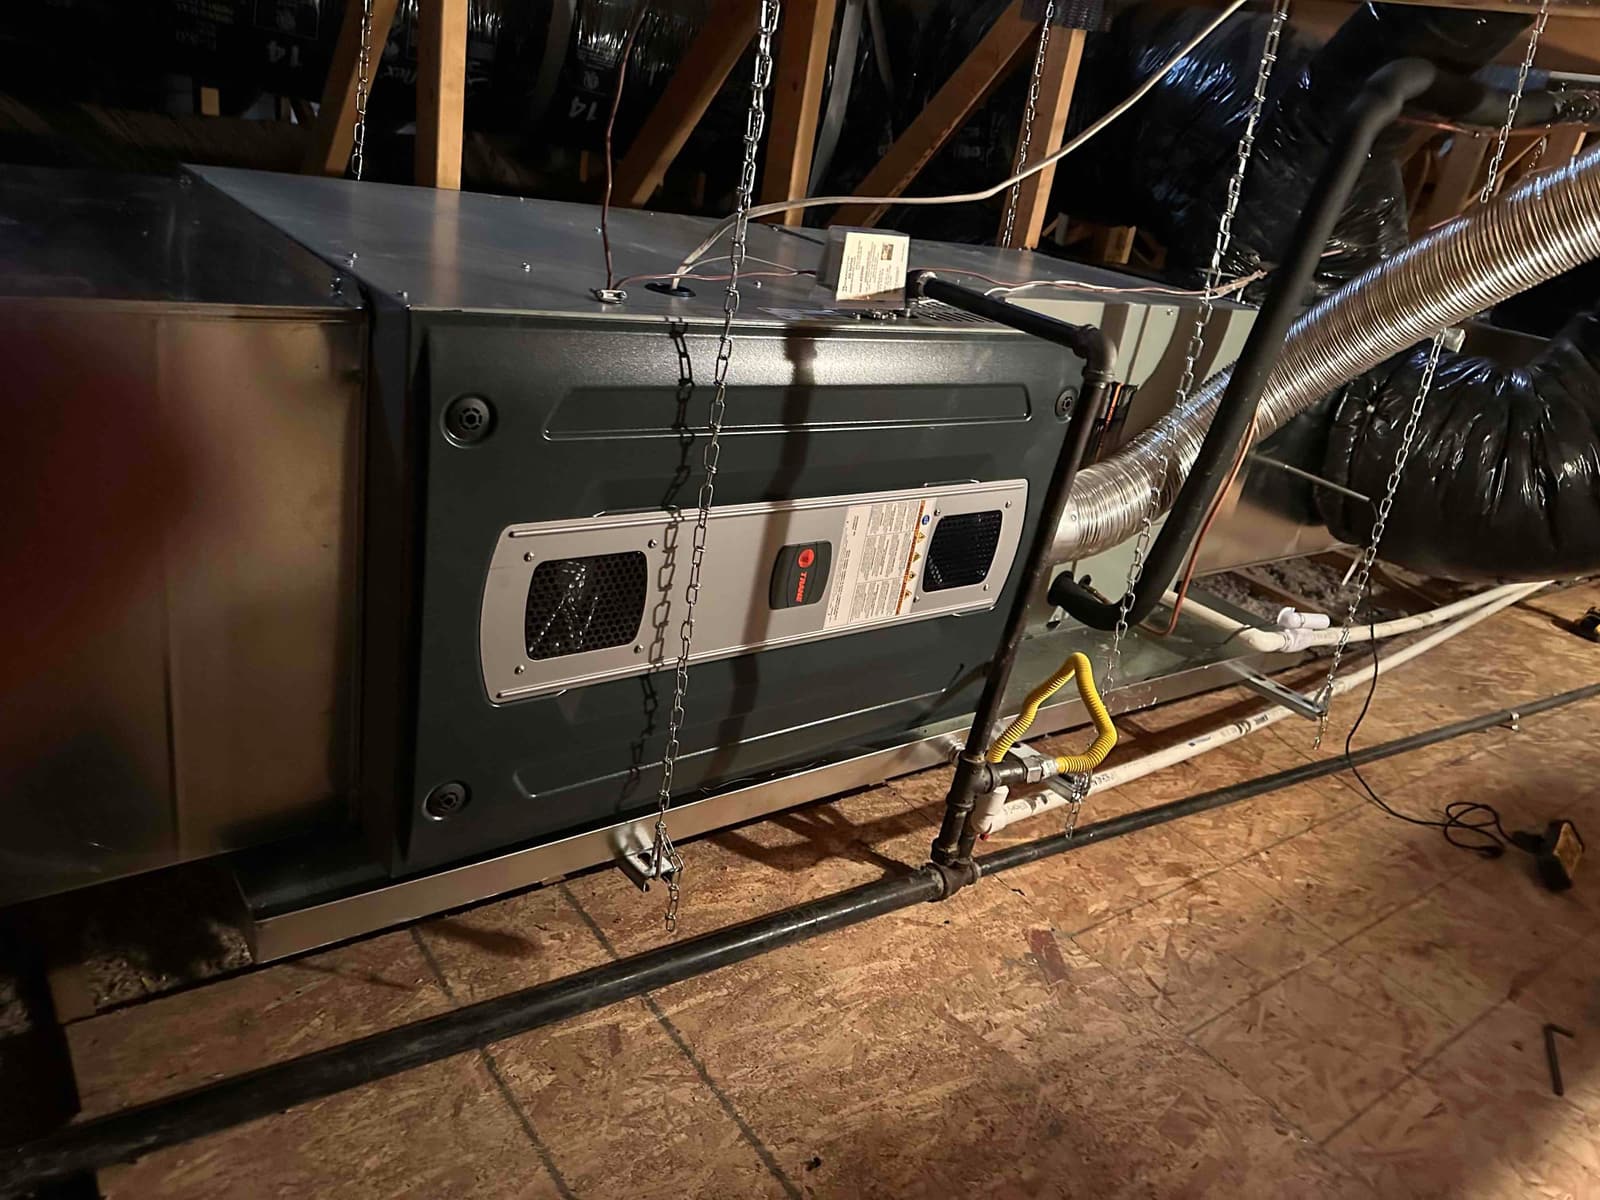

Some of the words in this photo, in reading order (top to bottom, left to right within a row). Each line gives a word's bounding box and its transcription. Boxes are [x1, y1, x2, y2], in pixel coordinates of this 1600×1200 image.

[265, 40, 303, 69] 14
[568, 95, 599, 121] 14
[795, 571, 808, 603] TRANE
